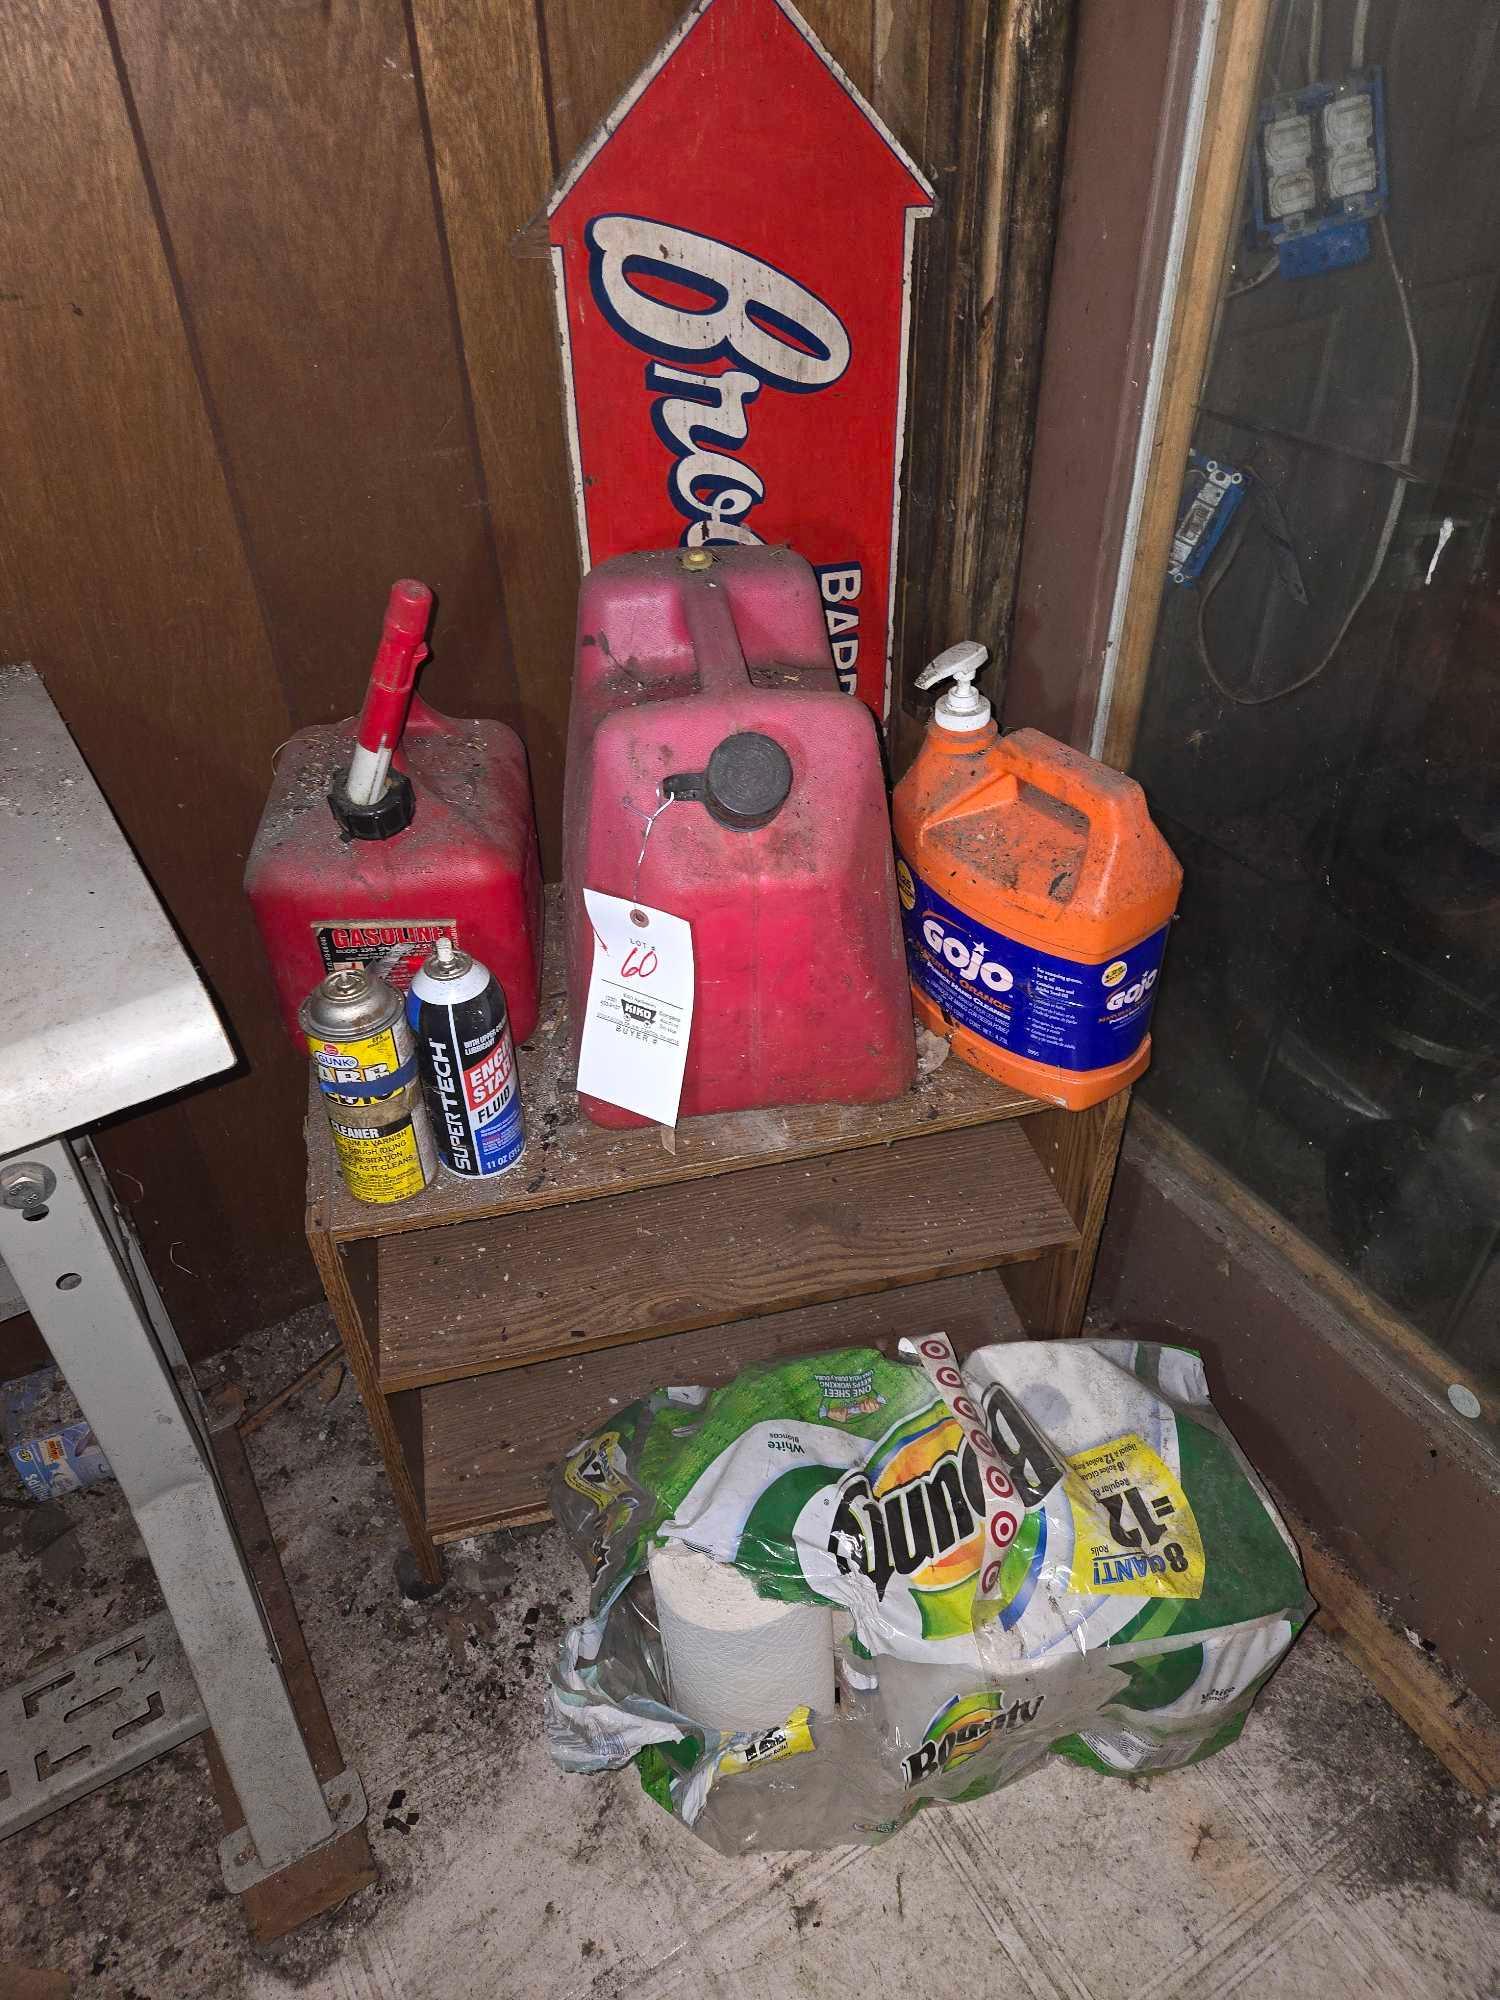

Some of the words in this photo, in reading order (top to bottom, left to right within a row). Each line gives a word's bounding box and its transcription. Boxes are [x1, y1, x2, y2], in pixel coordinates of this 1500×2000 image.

[629, 938, 647, 949] LOT
[621, 947, 658, 977] 60
[478, 1084, 510, 1124] FLUID
[824, 1388, 851, 1398] SHEET
[853, 1385, 872, 1398] ONE
[768, 1441, 805, 1454] White
[1091, 1544, 1109, 1556] Rolls
[1164, 1542, 1189, 1572] 8
